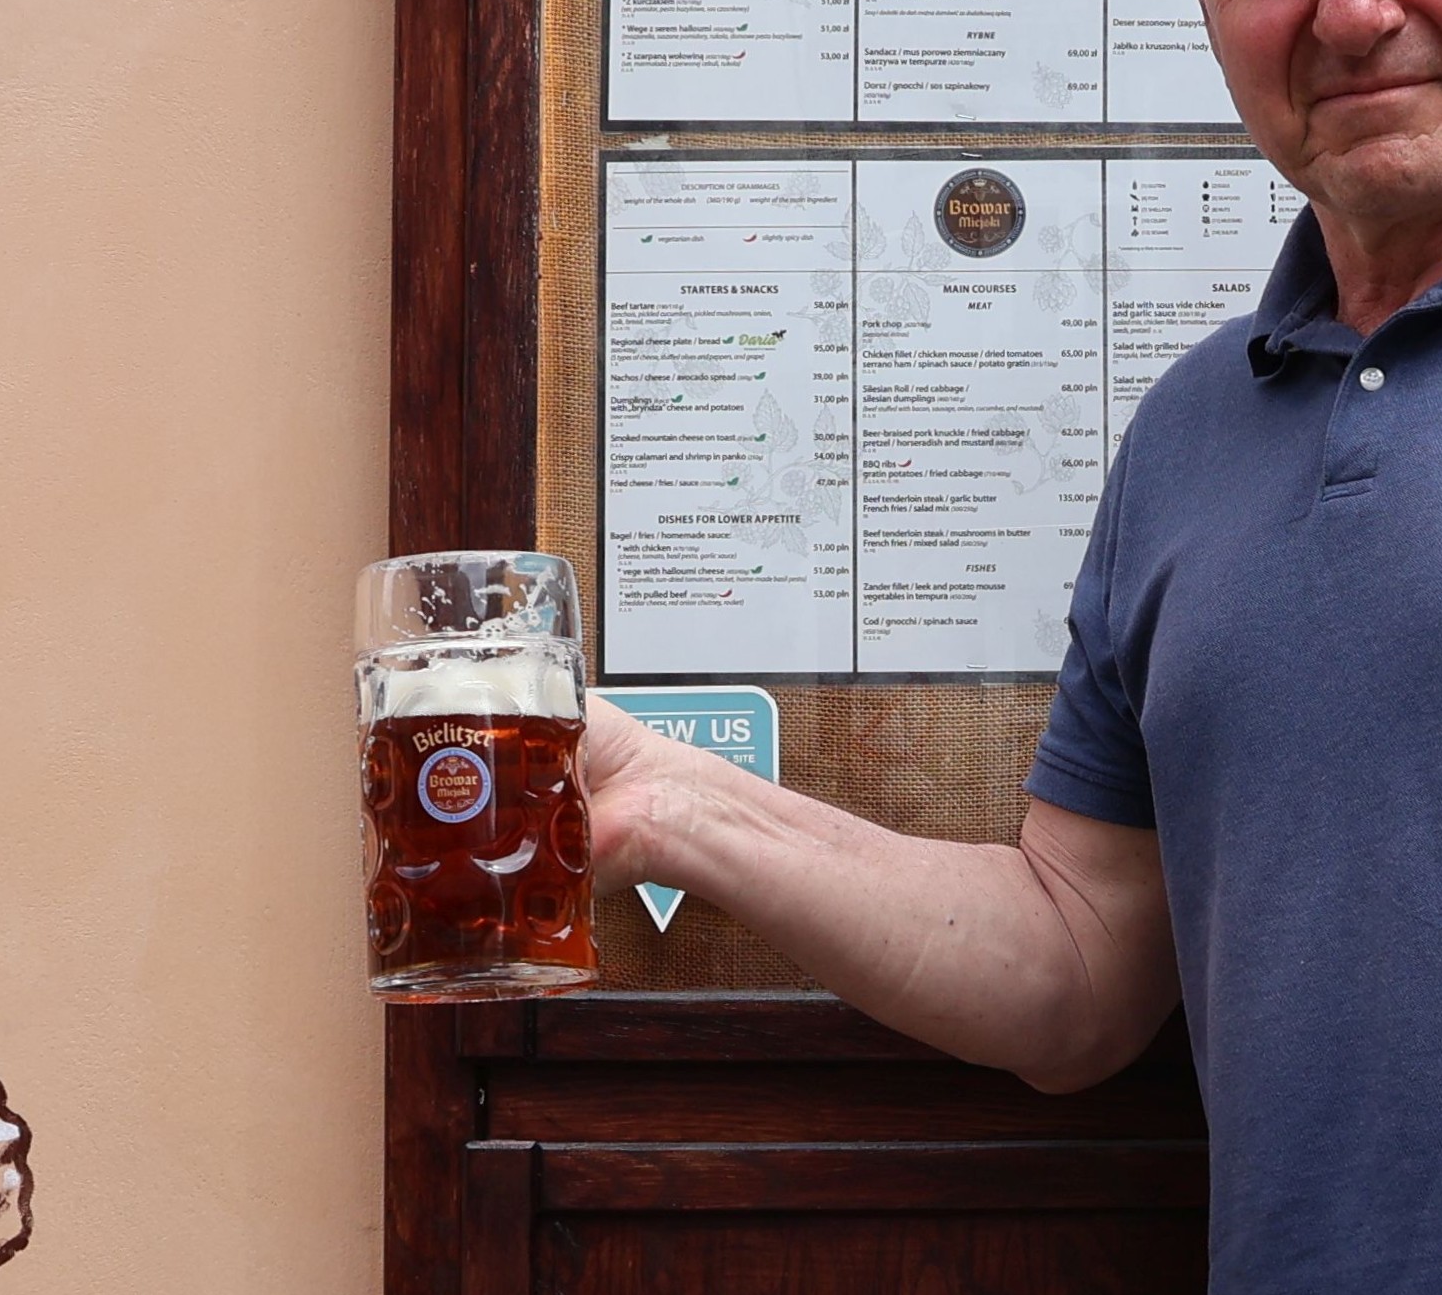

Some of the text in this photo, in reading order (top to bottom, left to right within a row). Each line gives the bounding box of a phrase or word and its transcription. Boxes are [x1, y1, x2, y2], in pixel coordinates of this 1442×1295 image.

[949, 200, 1011, 216] Browar
[681, 286, 728, 294] STARTERS
[740, 286, 778, 294] SNACKS
[972, 285, 1016, 293] COURSES
[1212, 284, 1250, 292] SALADS
[738, 334, 777, 346] Daria
[658, 516, 694, 524] DISHES
[718, 515, 752, 523] LOWER
[754, 515, 801, 523] APPETITE
[711, 718, 751, 743] US
[412, 722, 494, 753] Bielitzer
[734, 754, 755, 763] SITE
[429, 775, 478, 788] Browar
